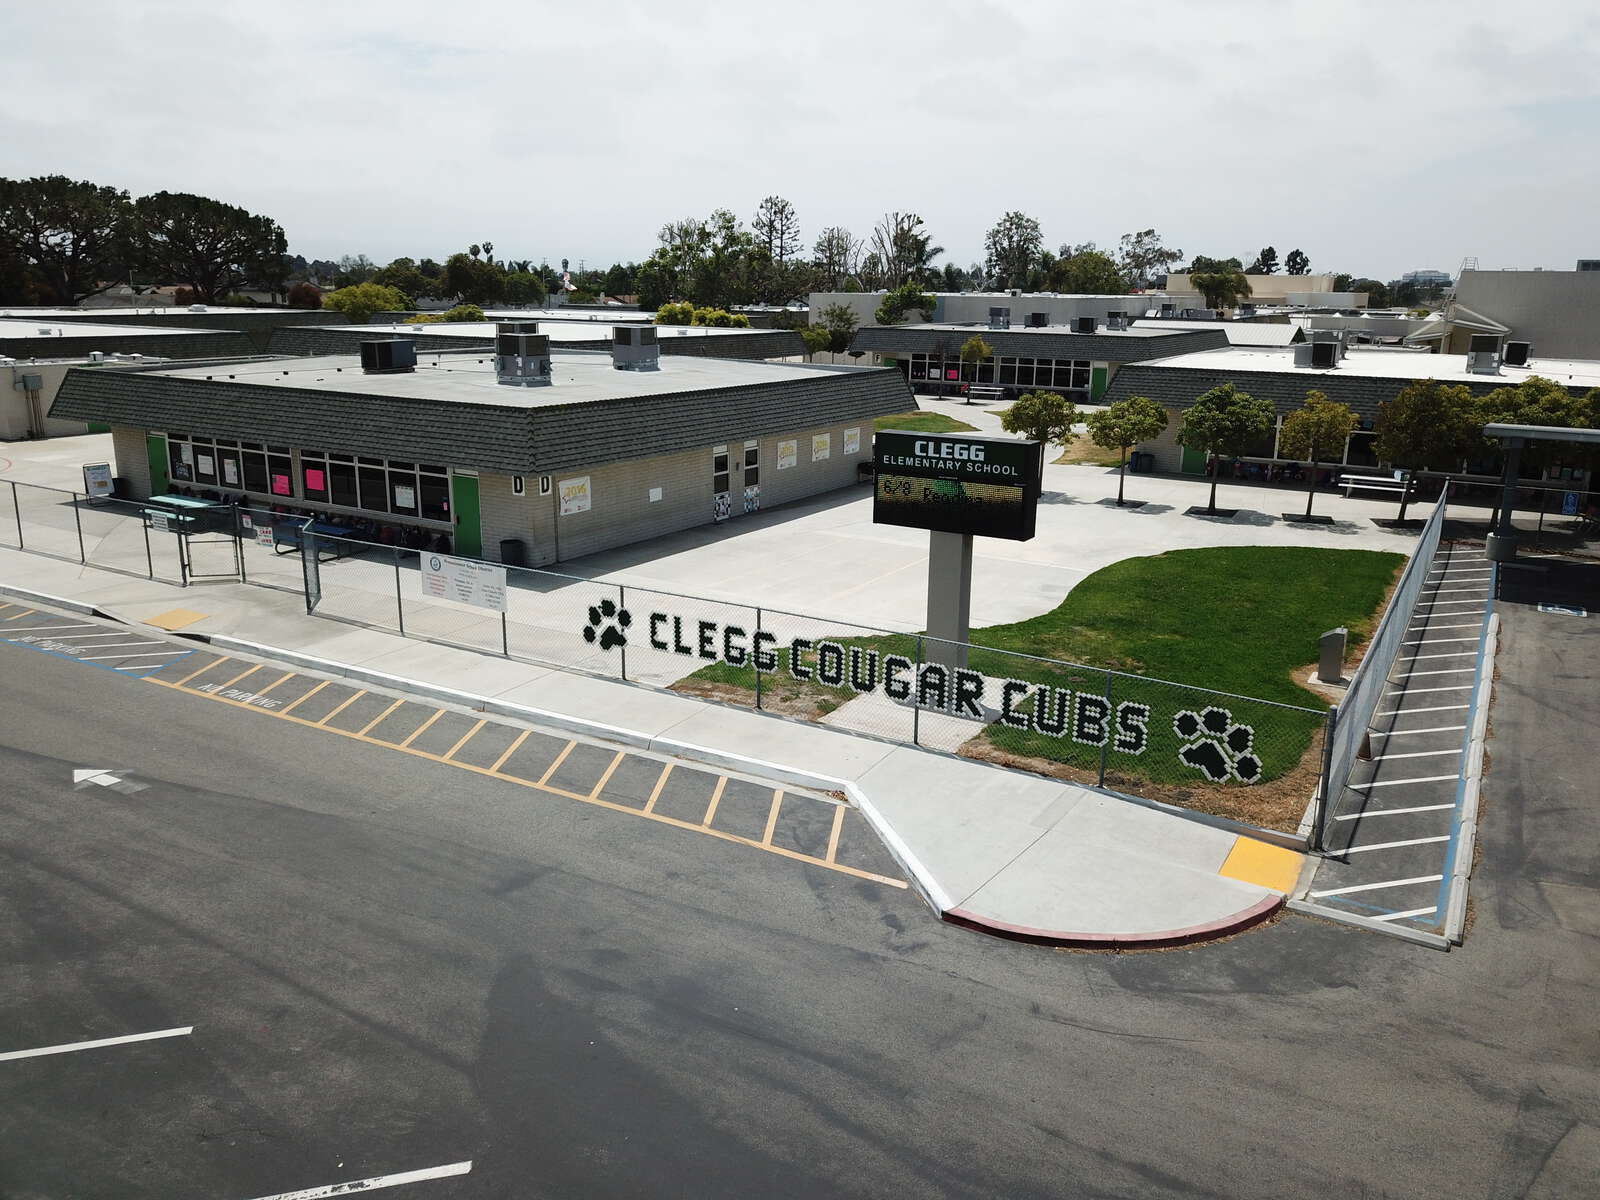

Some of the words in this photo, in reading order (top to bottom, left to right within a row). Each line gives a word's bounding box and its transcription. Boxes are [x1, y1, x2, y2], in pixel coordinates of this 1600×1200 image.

[914, 440, 985, 462] CLEGG
[883, 455, 961, 471] ELEMENTARY
[966, 462, 1018, 476] SCHOOL
[513, 475, 523, 493] D
[541, 476, 550, 493] D
[650, 612, 778, 671] CLEGG
[788, 638, 986, 720] COUGAR
[1000, 678, 1151, 756] CUBS
[219, 689, 282, 708] PARKING
